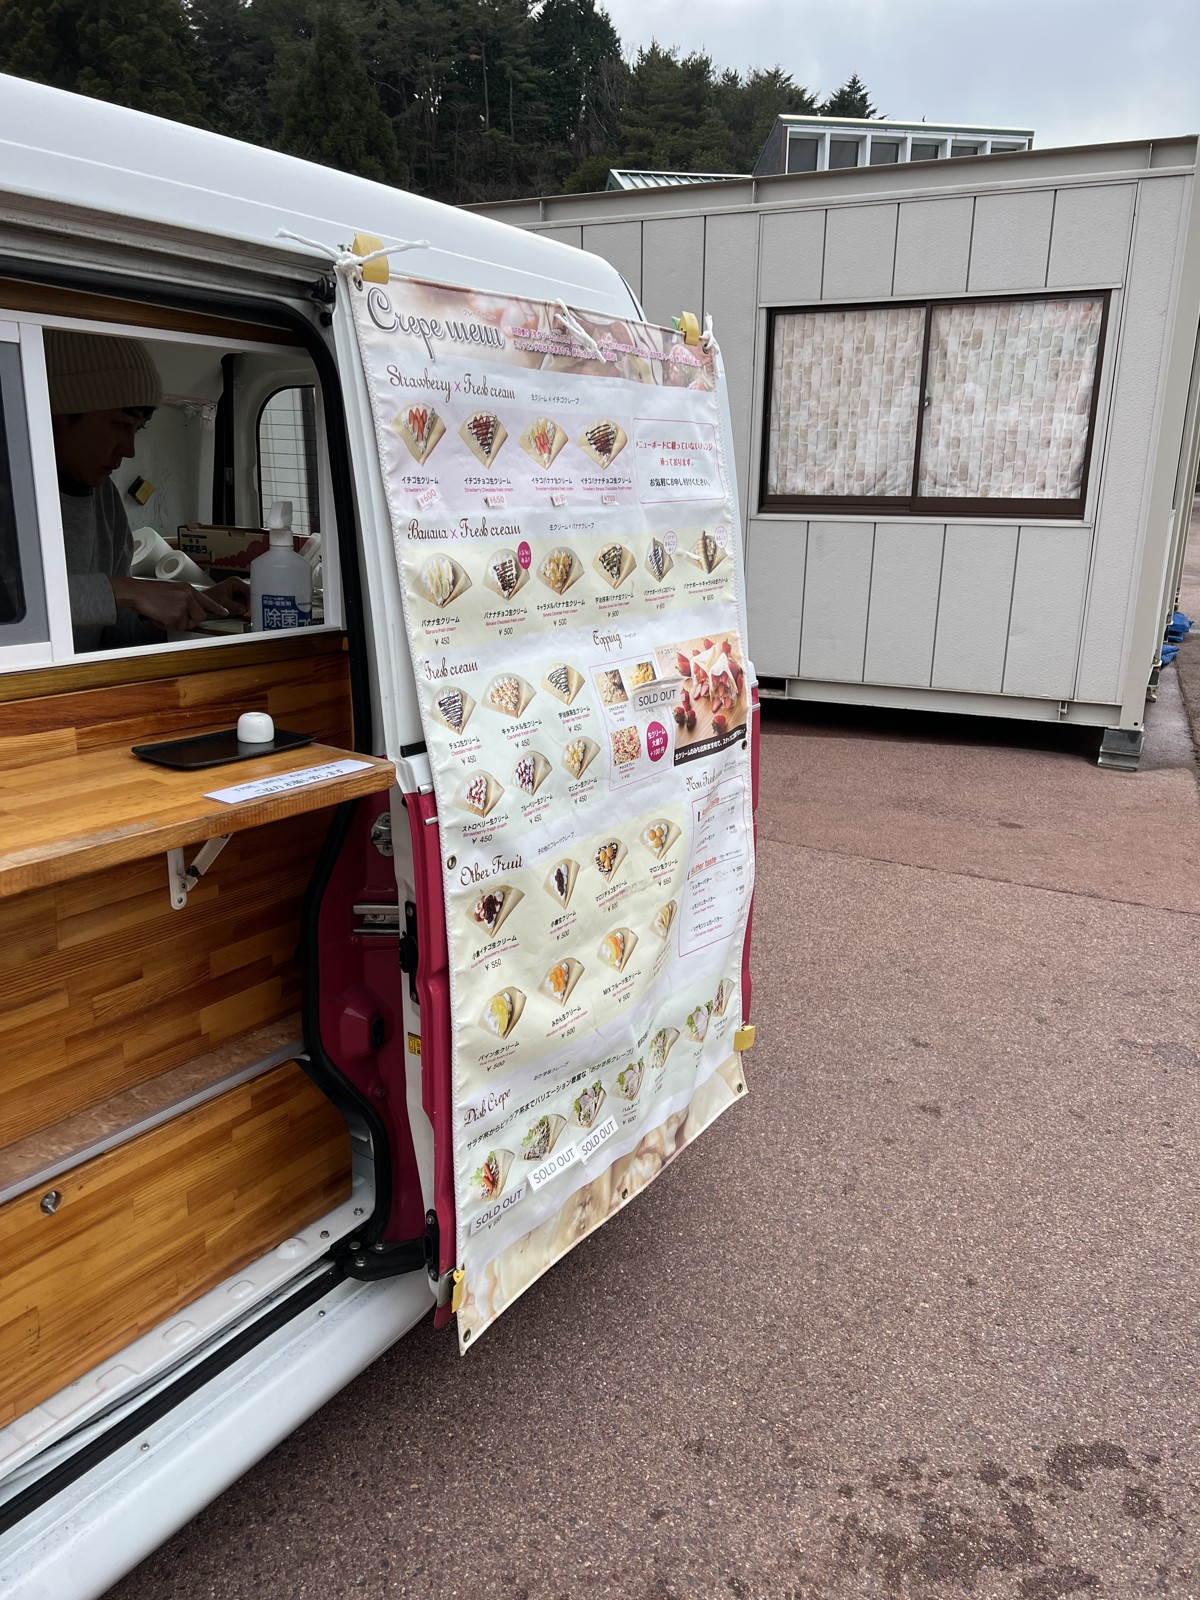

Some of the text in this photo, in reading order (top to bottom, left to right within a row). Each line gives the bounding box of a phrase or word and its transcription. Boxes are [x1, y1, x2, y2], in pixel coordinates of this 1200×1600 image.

[367, 287, 443, 360] Crepe
[445, 320, 505, 348] menu
[386, 365, 451, 402] Strawberry
[463, 373, 488, 397] Fresh
[490, 386, 516, 400] cream
[402, 476, 439, 484] イチゴ生クリーム
[420, 489, 437, 504] ¥600
[408, 519, 448, 540] Banana
[460, 517, 488, 538] Fresh
[490, 525, 520, 536] cream
[265, 609, 298, 627] 除菌
[421, 616, 460, 627] バナナ生クリーム
[484, 608, 527, 619] バナナチョコ生クリーム
[441, 637, 450, 645] 450
[593, 630, 622, 652] Topping
[424, 657, 479, 680] Fresh cream
[639, 690, 676, 707] SOLD OUT
[502, 719, 542, 735] キャラメル生クリーム
[648, 729, 666, 739] 生クリーム
[449, 736, 480, 750] チョコ生クリーム
[652, 737, 664, 747] 大盛り
[462, 814, 509, 832] ストロベリー生クリーム
[480, 834, 492, 843] 450
[460, 854, 523, 886] Other Fruit
[491, 958, 502, 969] 550
[493, 1060, 505, 1070] 500
[464, 1099, 486, 1128] Dish
[581, 1121, 615, 1156] SOLD OUT
[533, 1147, 576, 1184] SOLD OUT
[475, 1205, 500, 1229] SOLD
[502, 1188, 522, 1208] OUT
